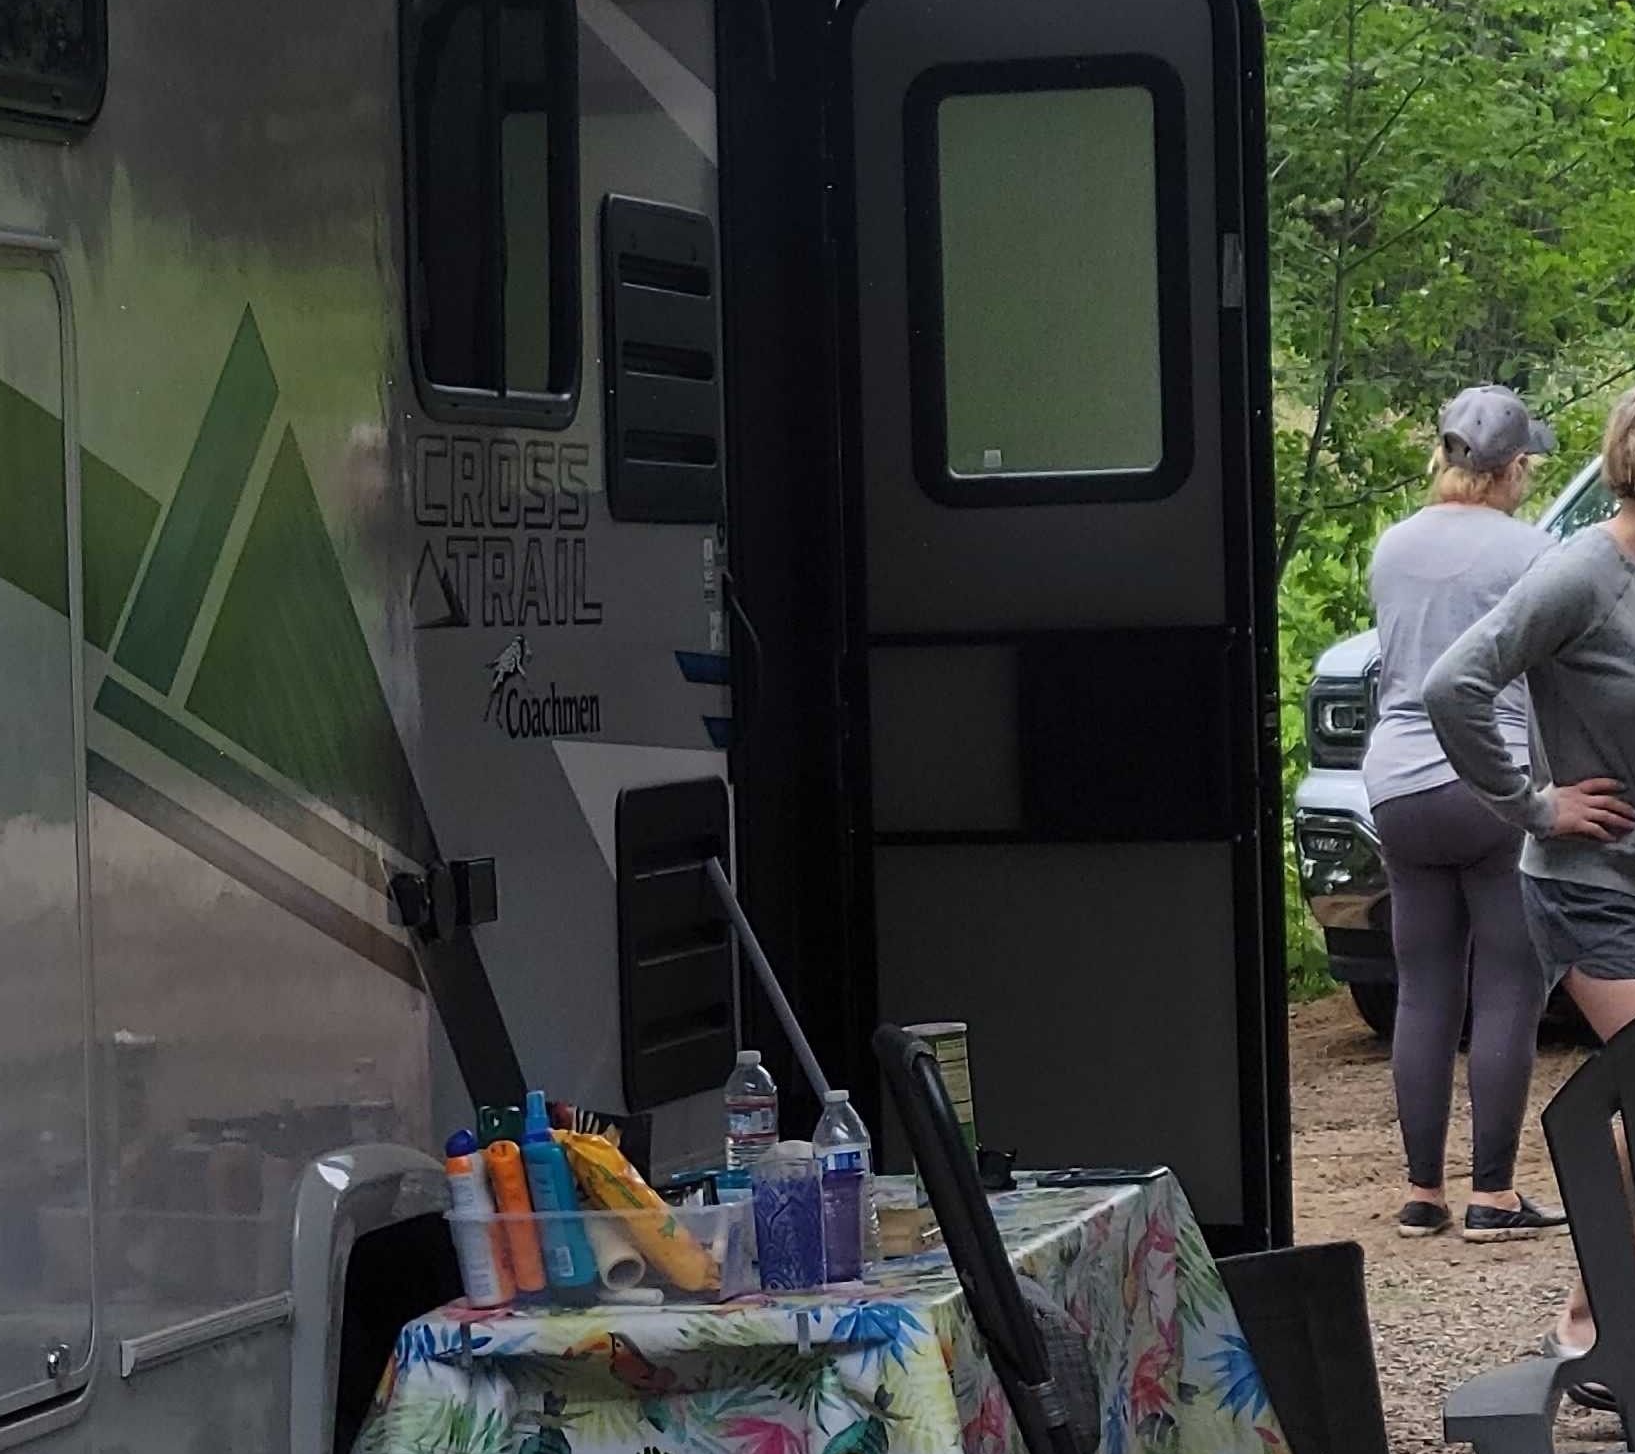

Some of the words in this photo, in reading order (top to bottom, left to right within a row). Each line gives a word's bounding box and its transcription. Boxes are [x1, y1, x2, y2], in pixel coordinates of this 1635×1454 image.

[414, 434, 589, 530] CROSS
[446, 535, 603, 627] TRAIL
[505, 681, 601, 739] Coachmen
